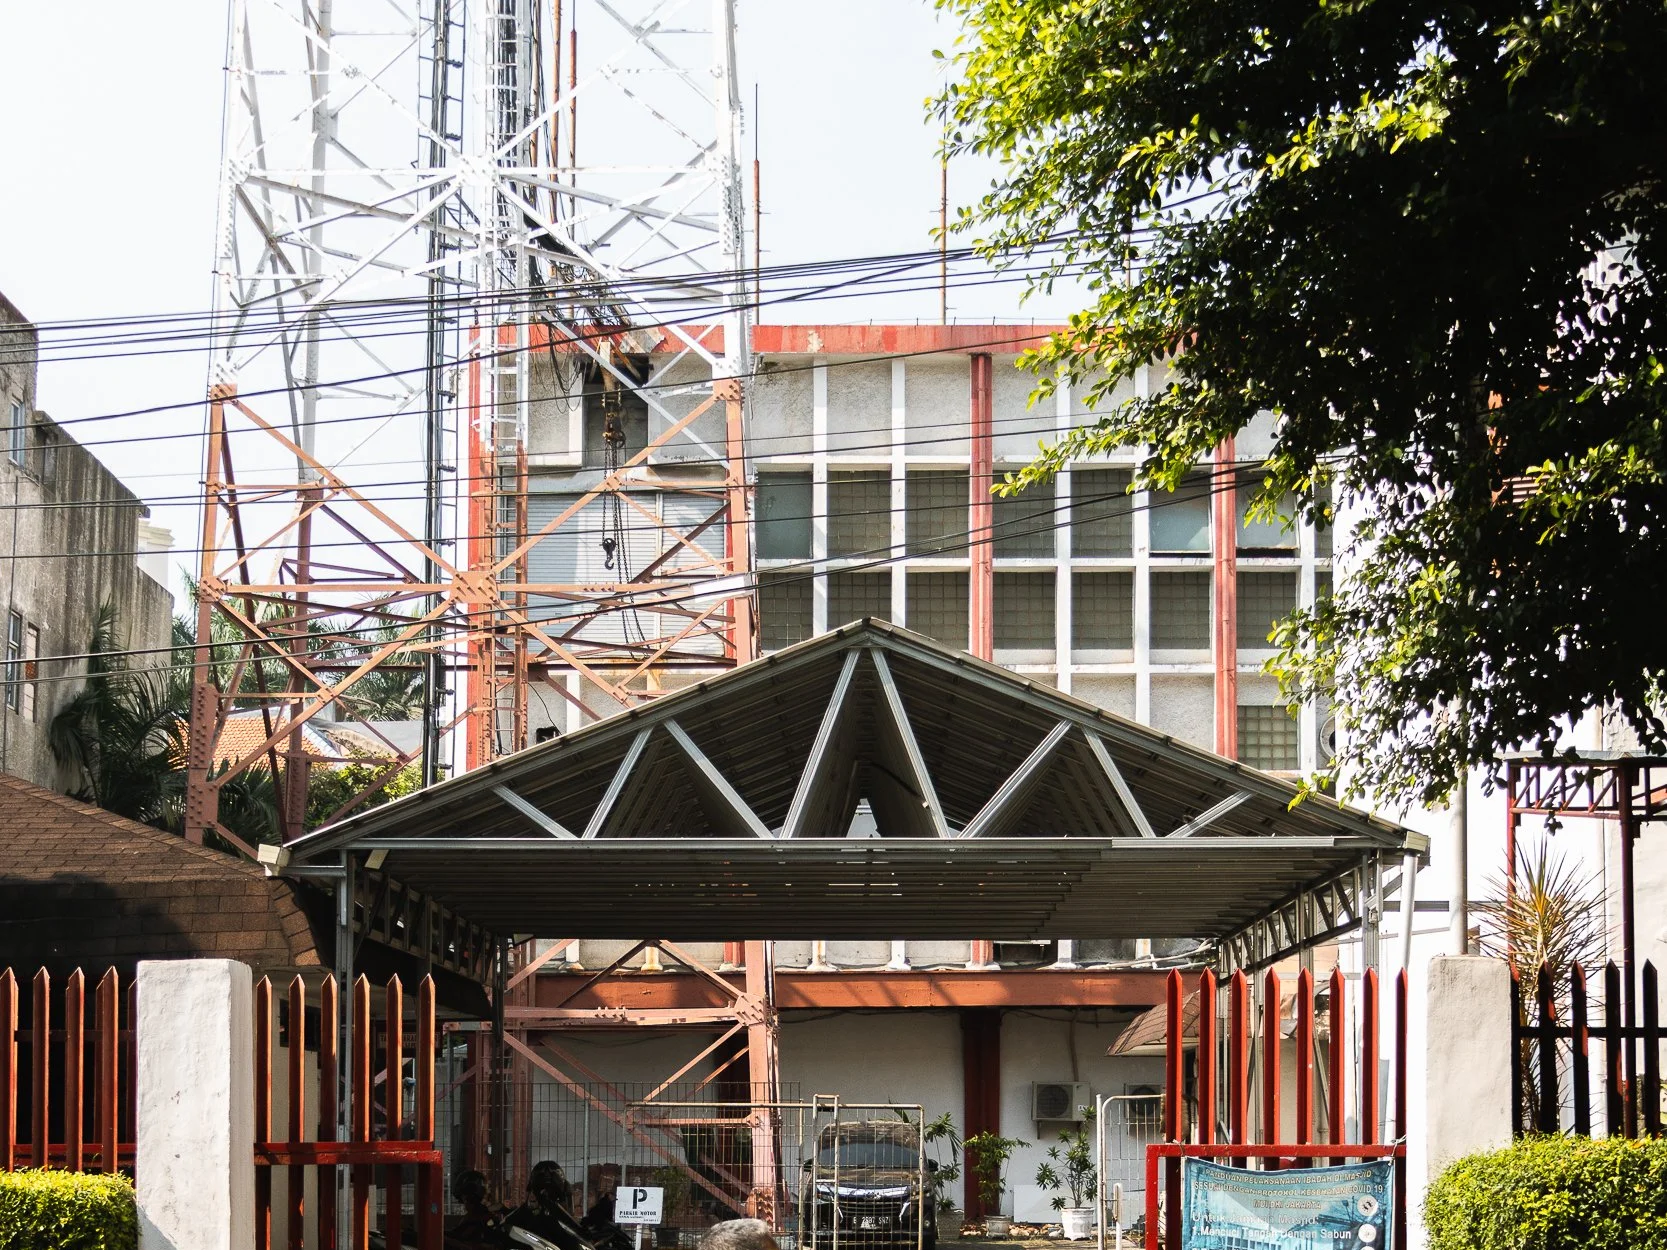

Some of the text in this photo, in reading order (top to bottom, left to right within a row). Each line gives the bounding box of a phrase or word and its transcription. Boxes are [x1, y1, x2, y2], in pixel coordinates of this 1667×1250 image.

[1205, 1168, 1372, 1185] PANDUAN PELAKSANAAN IBADAH DI MASJID
[1223, 1184, 1256, 1195] DENGAN
[1257, 1188, 1298, 1197] PROTOKOL
[1300, 1187, 1347, 1196] KESEHATAN
[1347, 1185, 1372, 1194] COVID
[1373, 1184, 1383, 1193] 19
[632, 1188, 648, 1209] P
[1285, 1200, 1322, 1209] JAKARTA
[1192, 1211, 1225, 1223] Untuk
[1242, 1227, 1276, 1239] Tangan
[1280, 1230, 1317, 1240] Dengan
[1320, 1228, 1351, 1239] Sabun
